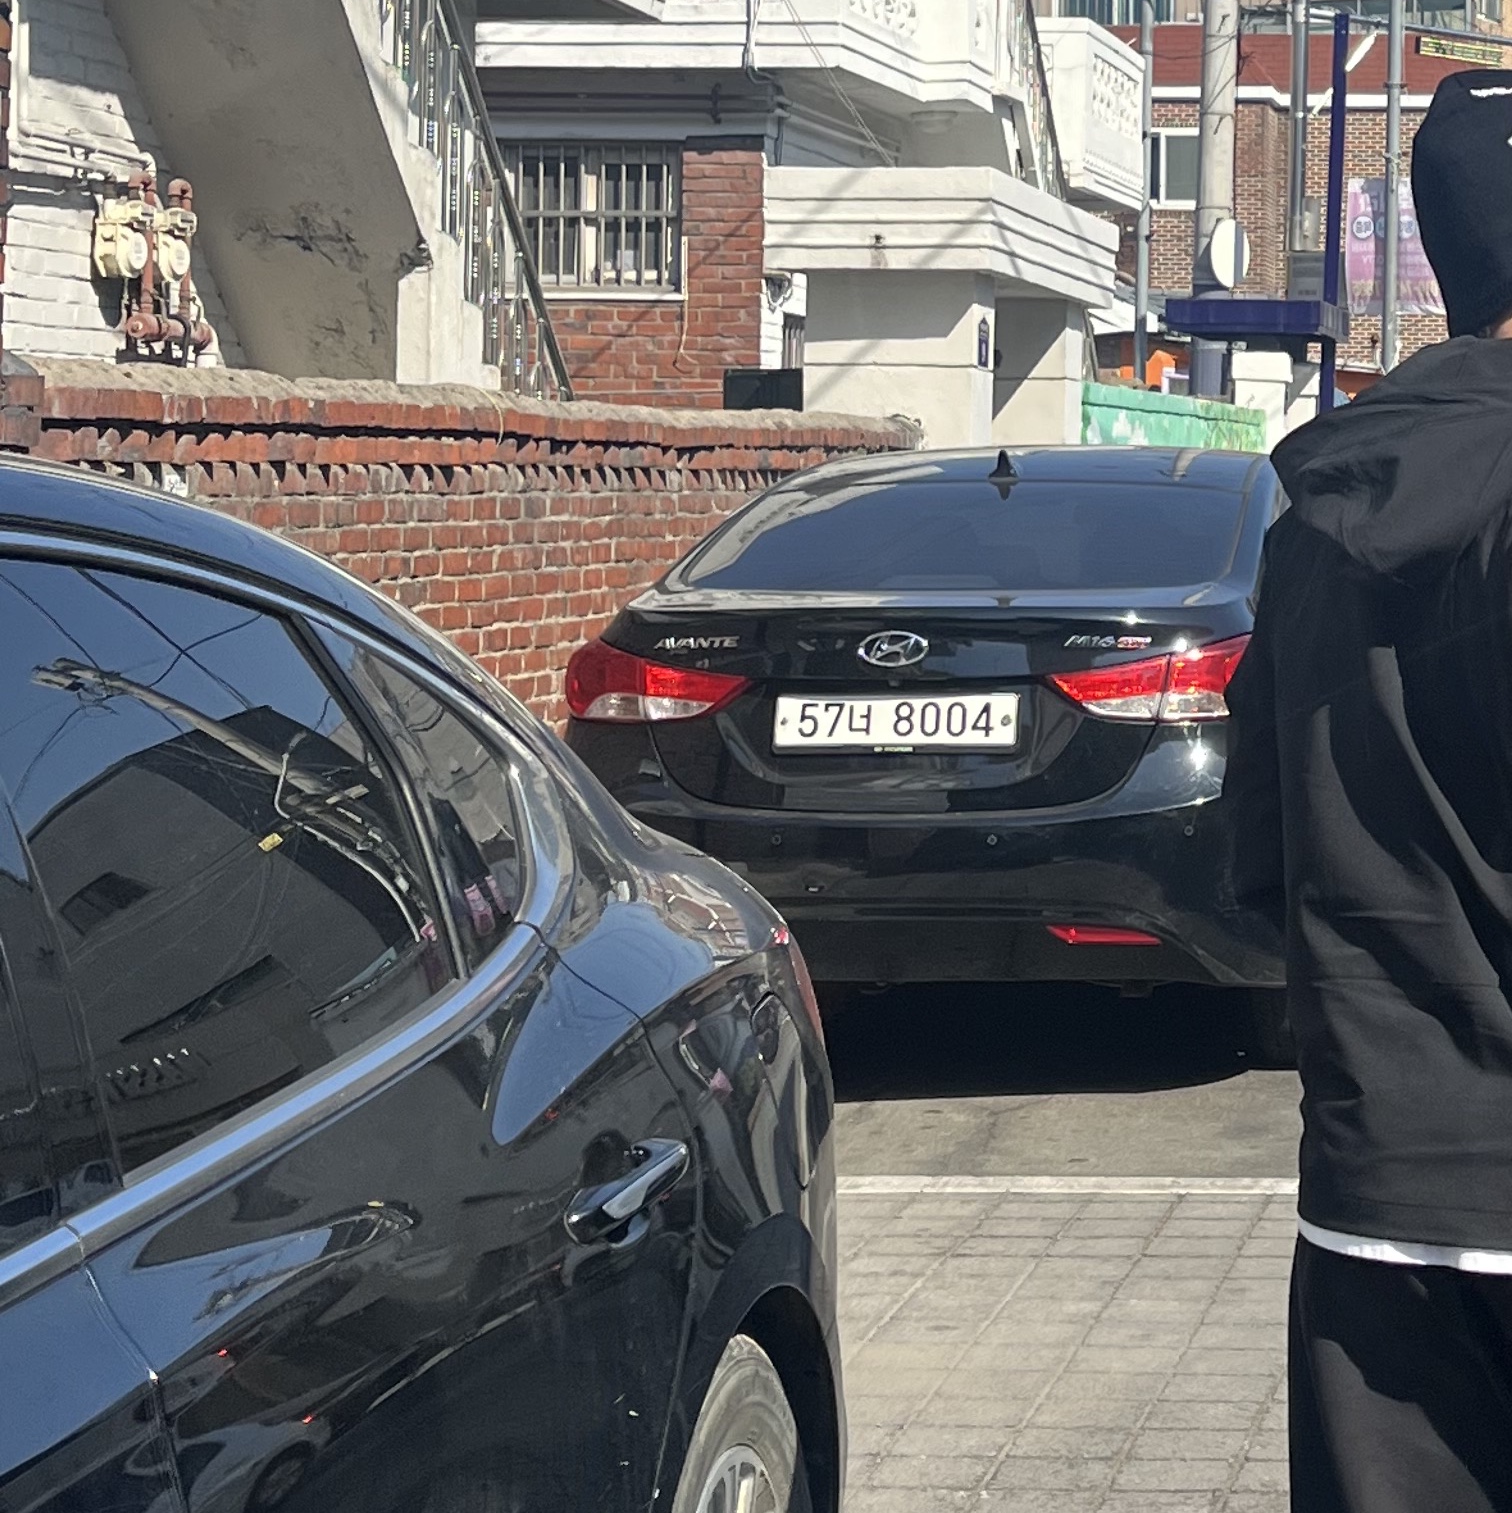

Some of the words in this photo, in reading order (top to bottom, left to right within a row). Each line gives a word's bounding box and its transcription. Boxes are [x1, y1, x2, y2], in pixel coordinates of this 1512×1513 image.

[653, 635, 740, 649] AVANTE
[798, 703, 872, 738] 57너
[893, 701, 995, 738] 8004
